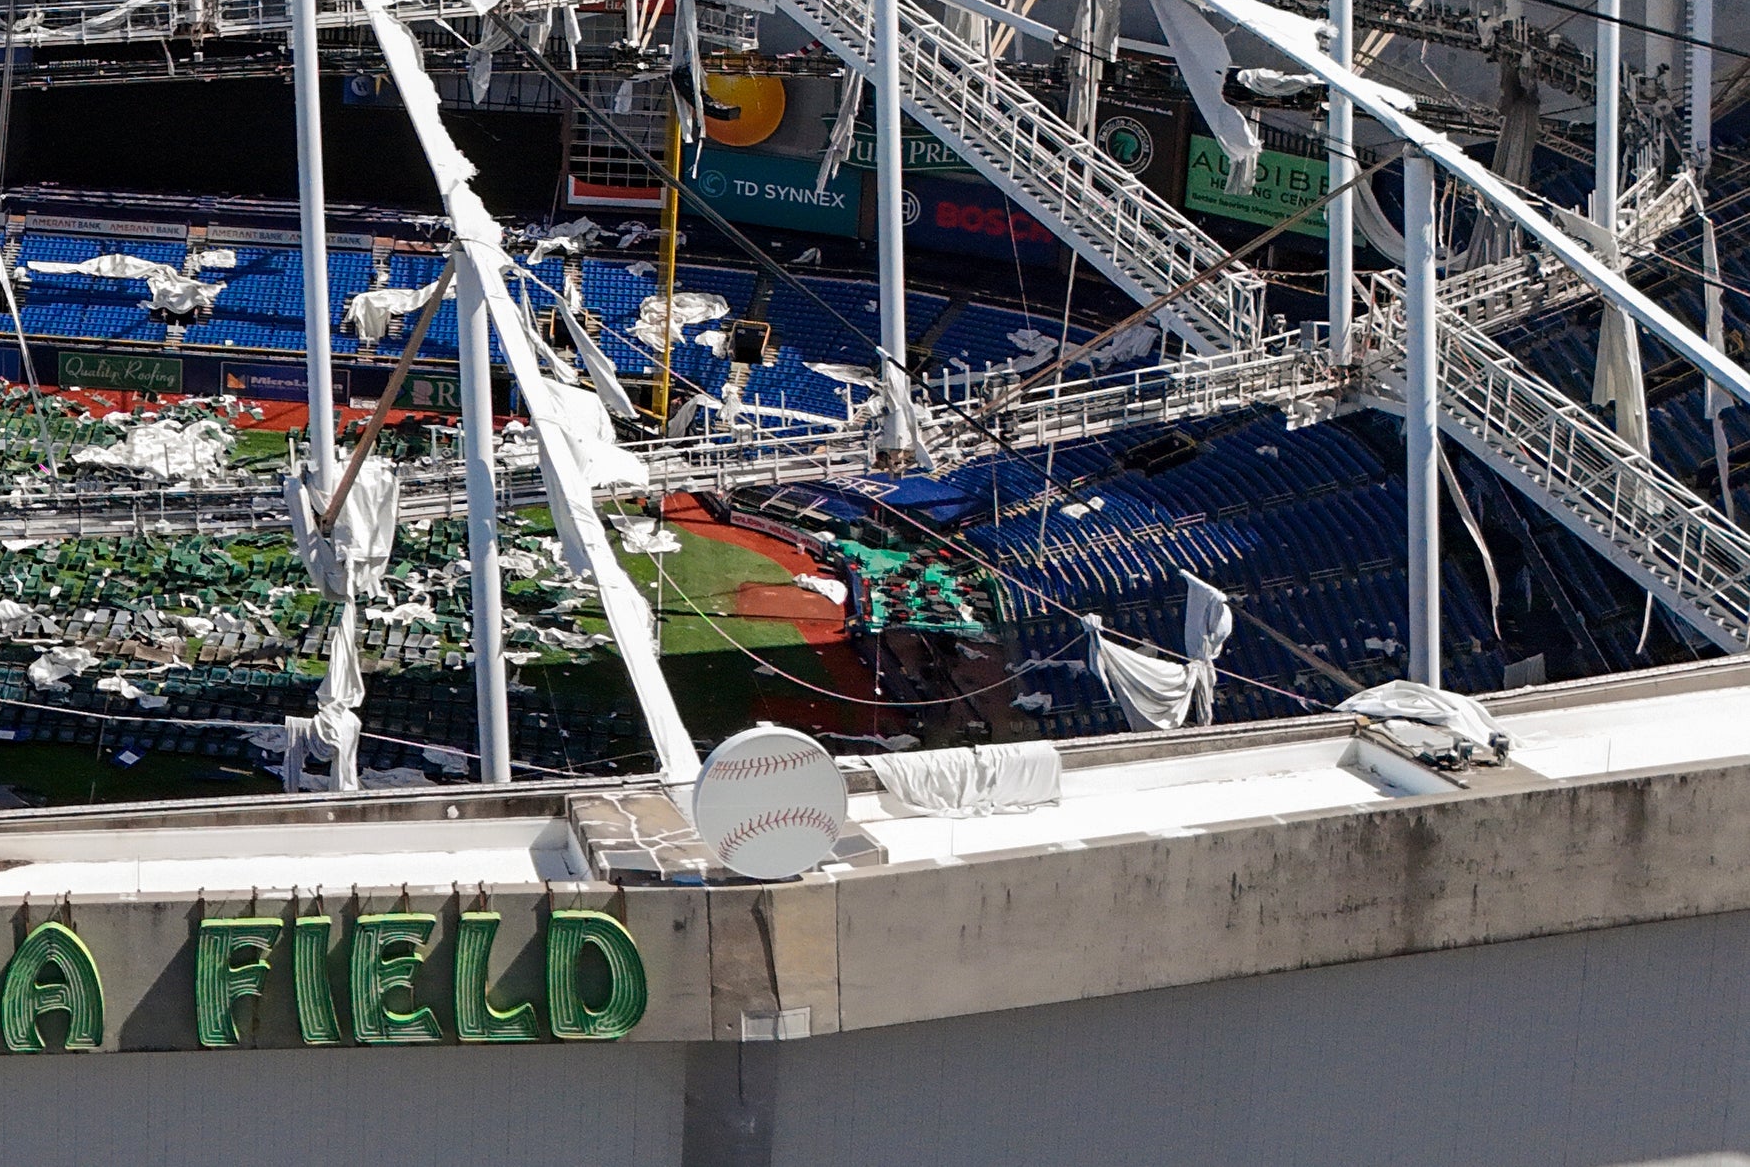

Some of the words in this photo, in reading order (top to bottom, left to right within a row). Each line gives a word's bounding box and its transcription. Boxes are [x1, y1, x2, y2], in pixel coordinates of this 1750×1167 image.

[733, 179, 758, 196] TD
[764, 184, 845, 209] SYNNEX
[32, 218, 76, 229] AMERANT
[77, 220, 100, 230] BANK
[109, 223, 155, 234] AMERANT
[156, 226, 180, 236] BANK
[212, 229, 257, 239] AMERANT
[259, 233, 282, 241] BANK
[337, 237, 361, 245] BANK
[65, 356, 119, 381] Quality
[123, 356, 176, 386] Roofing
[195, 910, 648, 1047] FIELD
